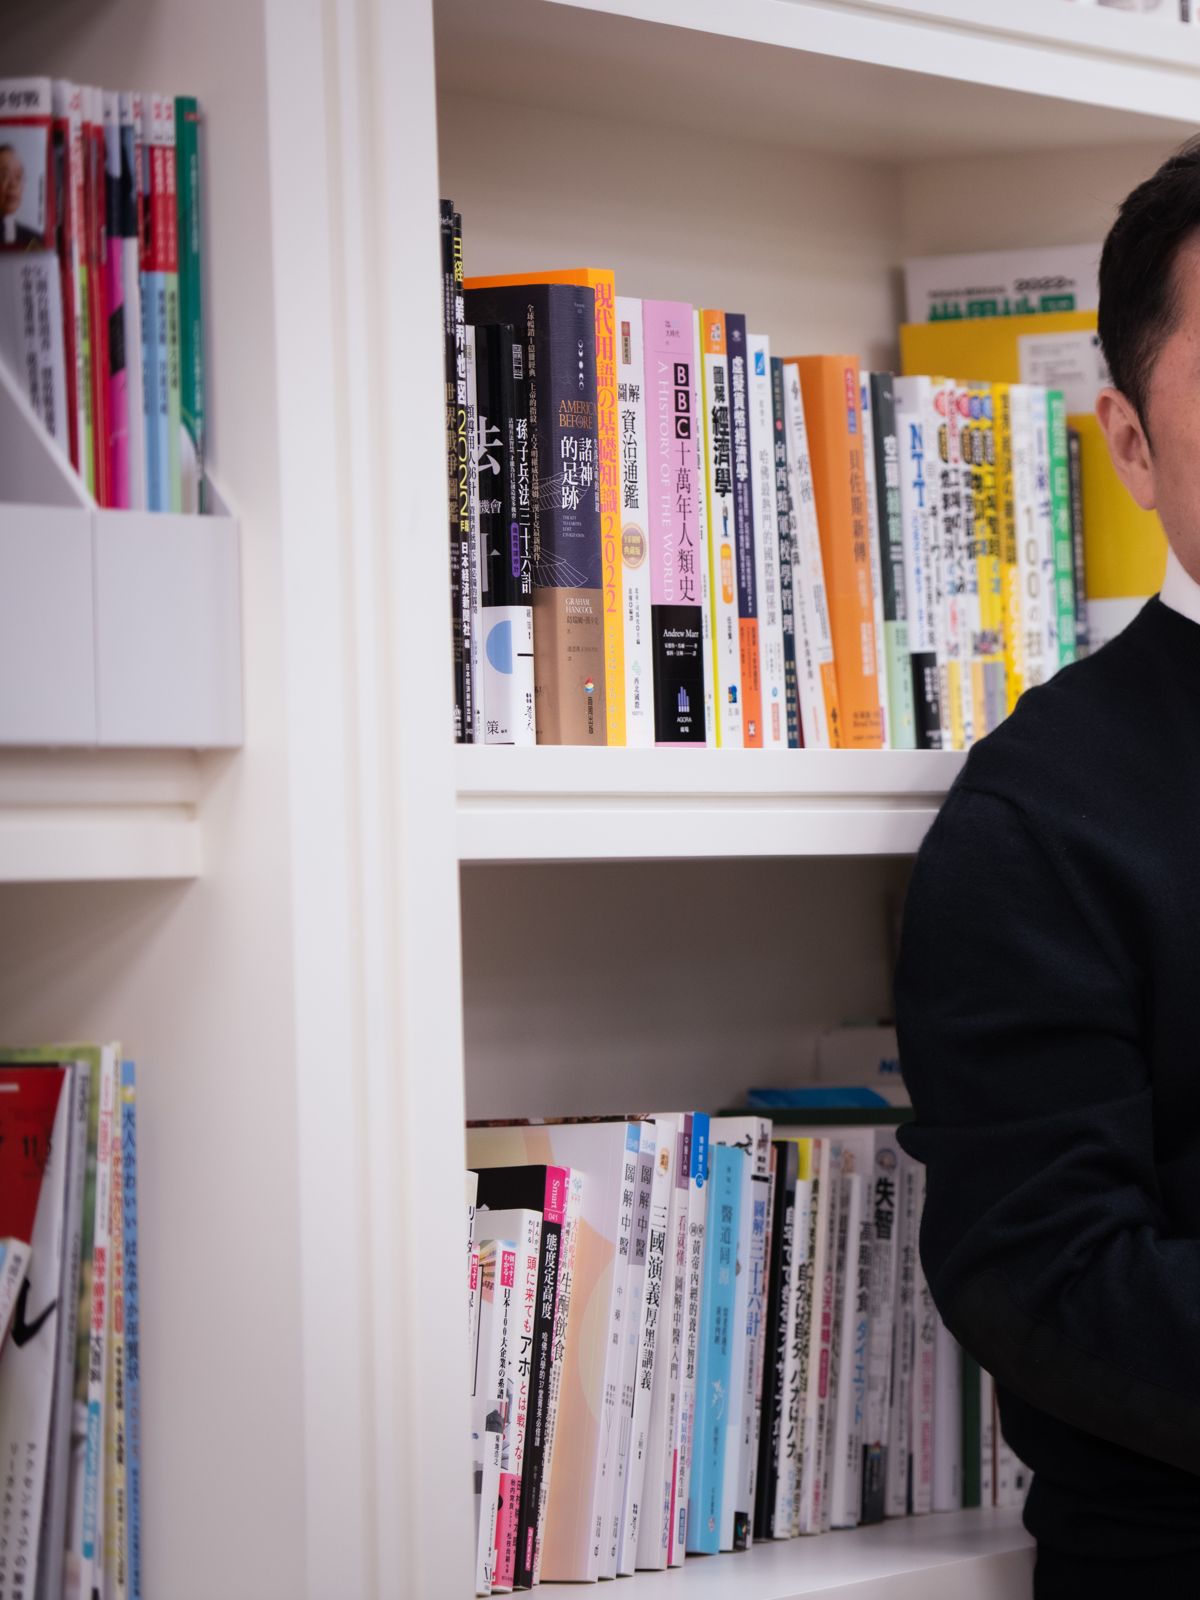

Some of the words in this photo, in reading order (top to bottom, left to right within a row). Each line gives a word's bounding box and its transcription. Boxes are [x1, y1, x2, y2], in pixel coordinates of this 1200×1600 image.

[559, 414, 592, 428] BEFORE
[658, 379, 670, 456] HISTORY
[621, 409, 640, 509] 資治通鑑
[515, 418, 532, 594] 孫子兵法三十六計
[661, 532, 674, 600] WORLD
[565, 598, 591, 606] GRAHAM
[565, 606, 593, 614] HANCOCK
[663, 629, 685, 638] Andrew
[685, 629, 699, 638] Marr
[550, 1179, 561, 1209] Smart
[541, 1233, 558, 1320] 態度定高度
[641, 1206, 667, 1390] 三國演義厚黑講義
